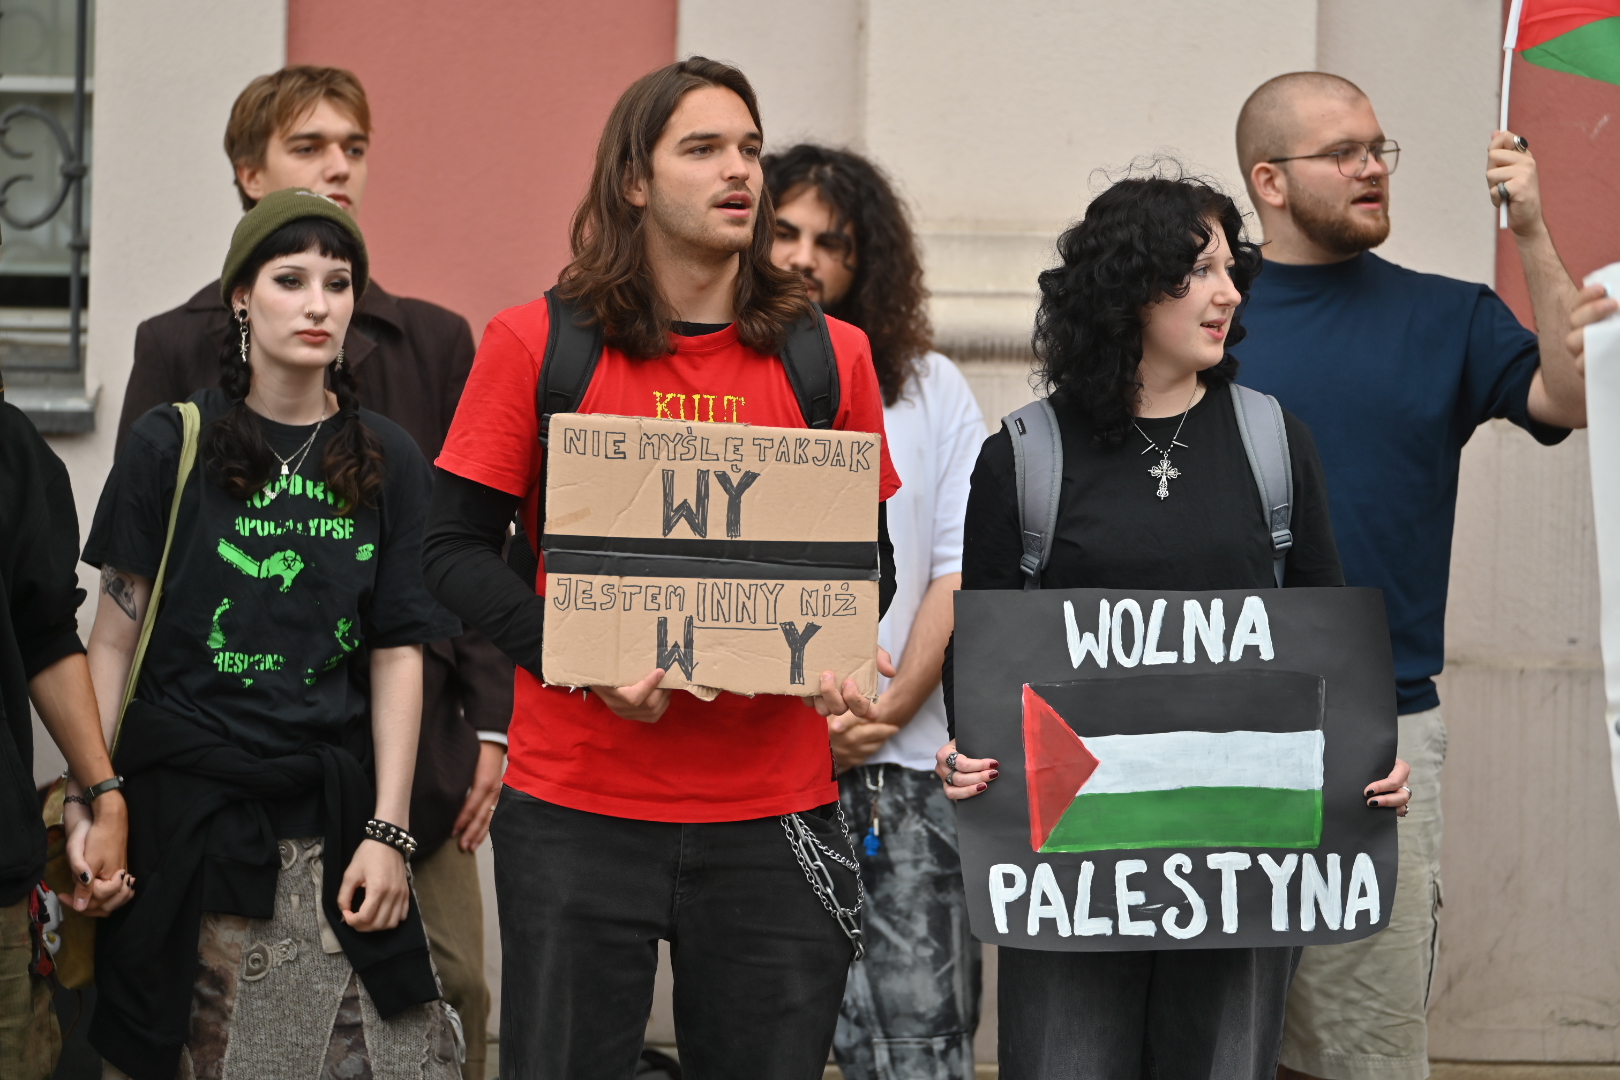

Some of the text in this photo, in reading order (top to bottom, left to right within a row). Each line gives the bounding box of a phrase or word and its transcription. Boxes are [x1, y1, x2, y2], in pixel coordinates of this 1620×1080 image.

[564, 428, 627, 460] NIE
[639, 426, 744, 473] MYŚLĘ
[662, 469, 760, 538] WY
[553, 578, 686, 612] JESTEM
[696, 582, 784, 625] INNY
[1063, 596, 1274, 669] WOLNA
[988, 852, 1380, 940] PALESTYNA
